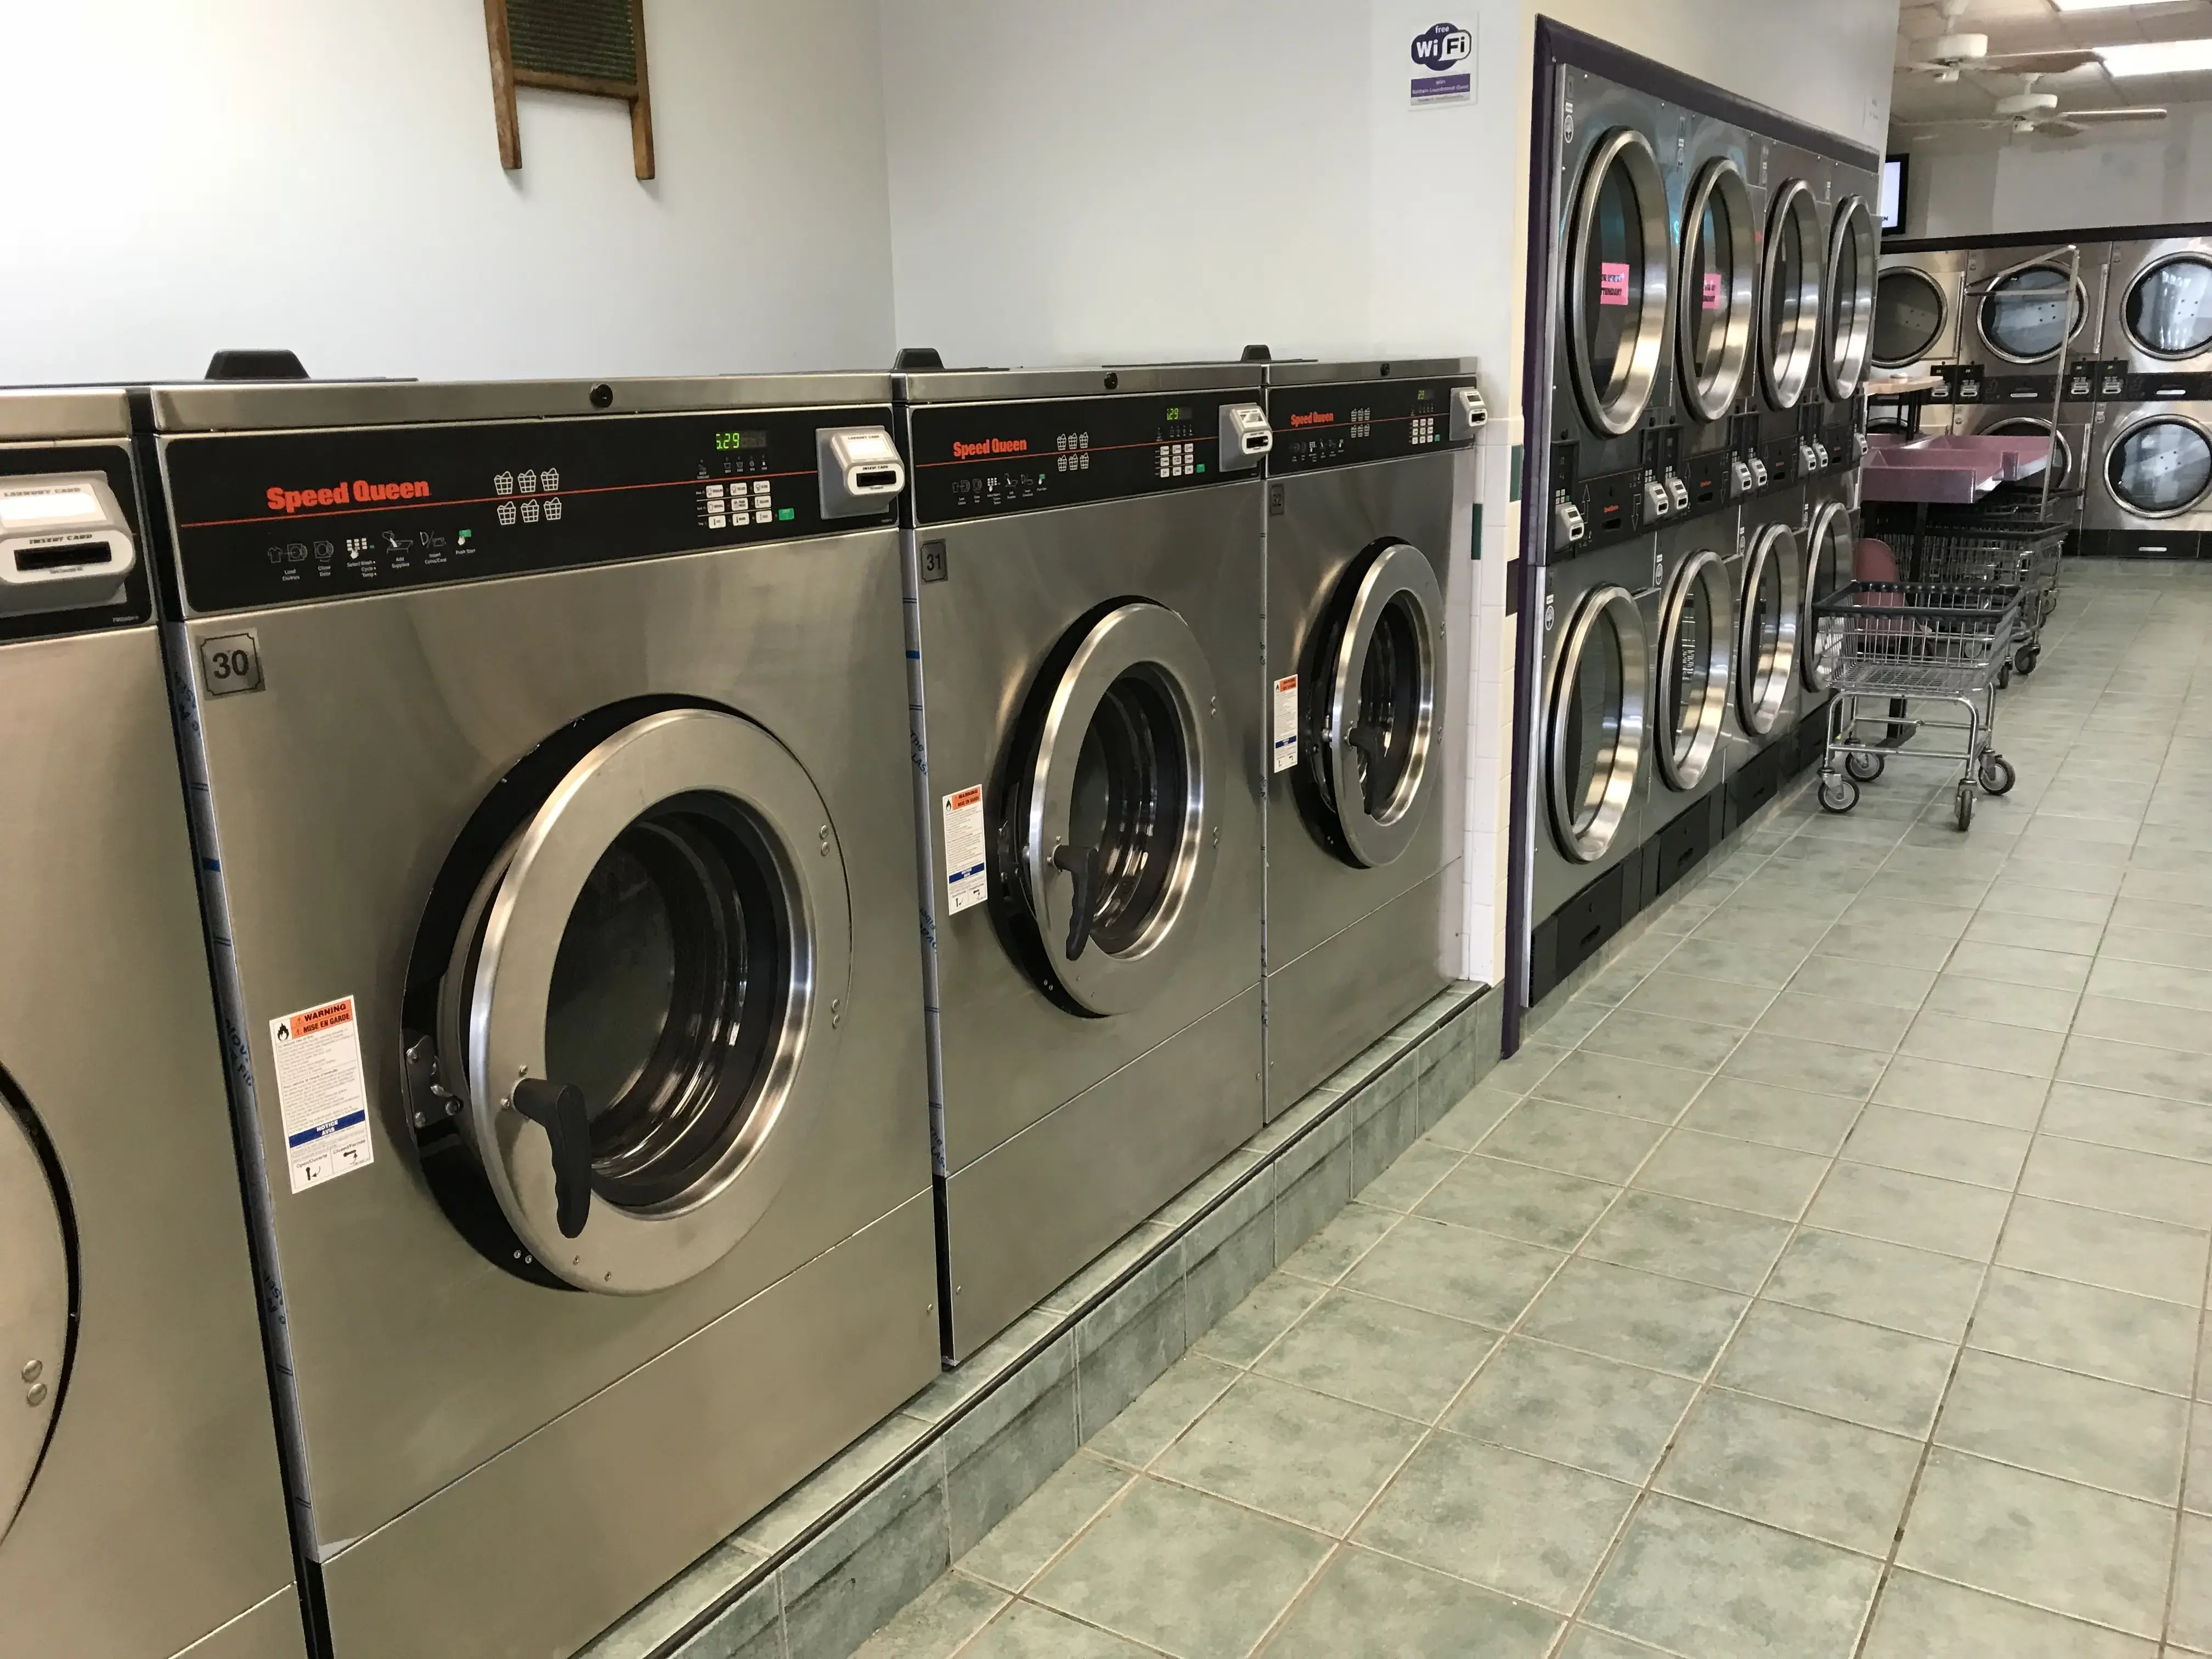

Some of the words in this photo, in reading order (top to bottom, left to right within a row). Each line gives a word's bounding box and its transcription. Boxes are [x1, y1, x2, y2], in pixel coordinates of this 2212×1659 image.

[1291, 412, 1312, 427] Speed
[1313, 411, 1334, 422] Queen
[953, 439, 990, 459] Speed
[991, 438, 1027, 453] Queen
[267, 482, 349, 513] Speed
[353, 479, 430, 501] Queen
[29, 536, 64, 544] INSERT
[927, 553, 941, 571] 31
[212, 650, 249, 679] 30
[304, 1003, 346, 1022] WARNING
[303, 1022, 319, 1034] MISE
[320, 1019, 328, 1028] EN
[330, 1013, 350, 1025] GARDE
[316, 1120, 338, 1132] NOTICE
[321, 1126, 335, 1136] AVIS
